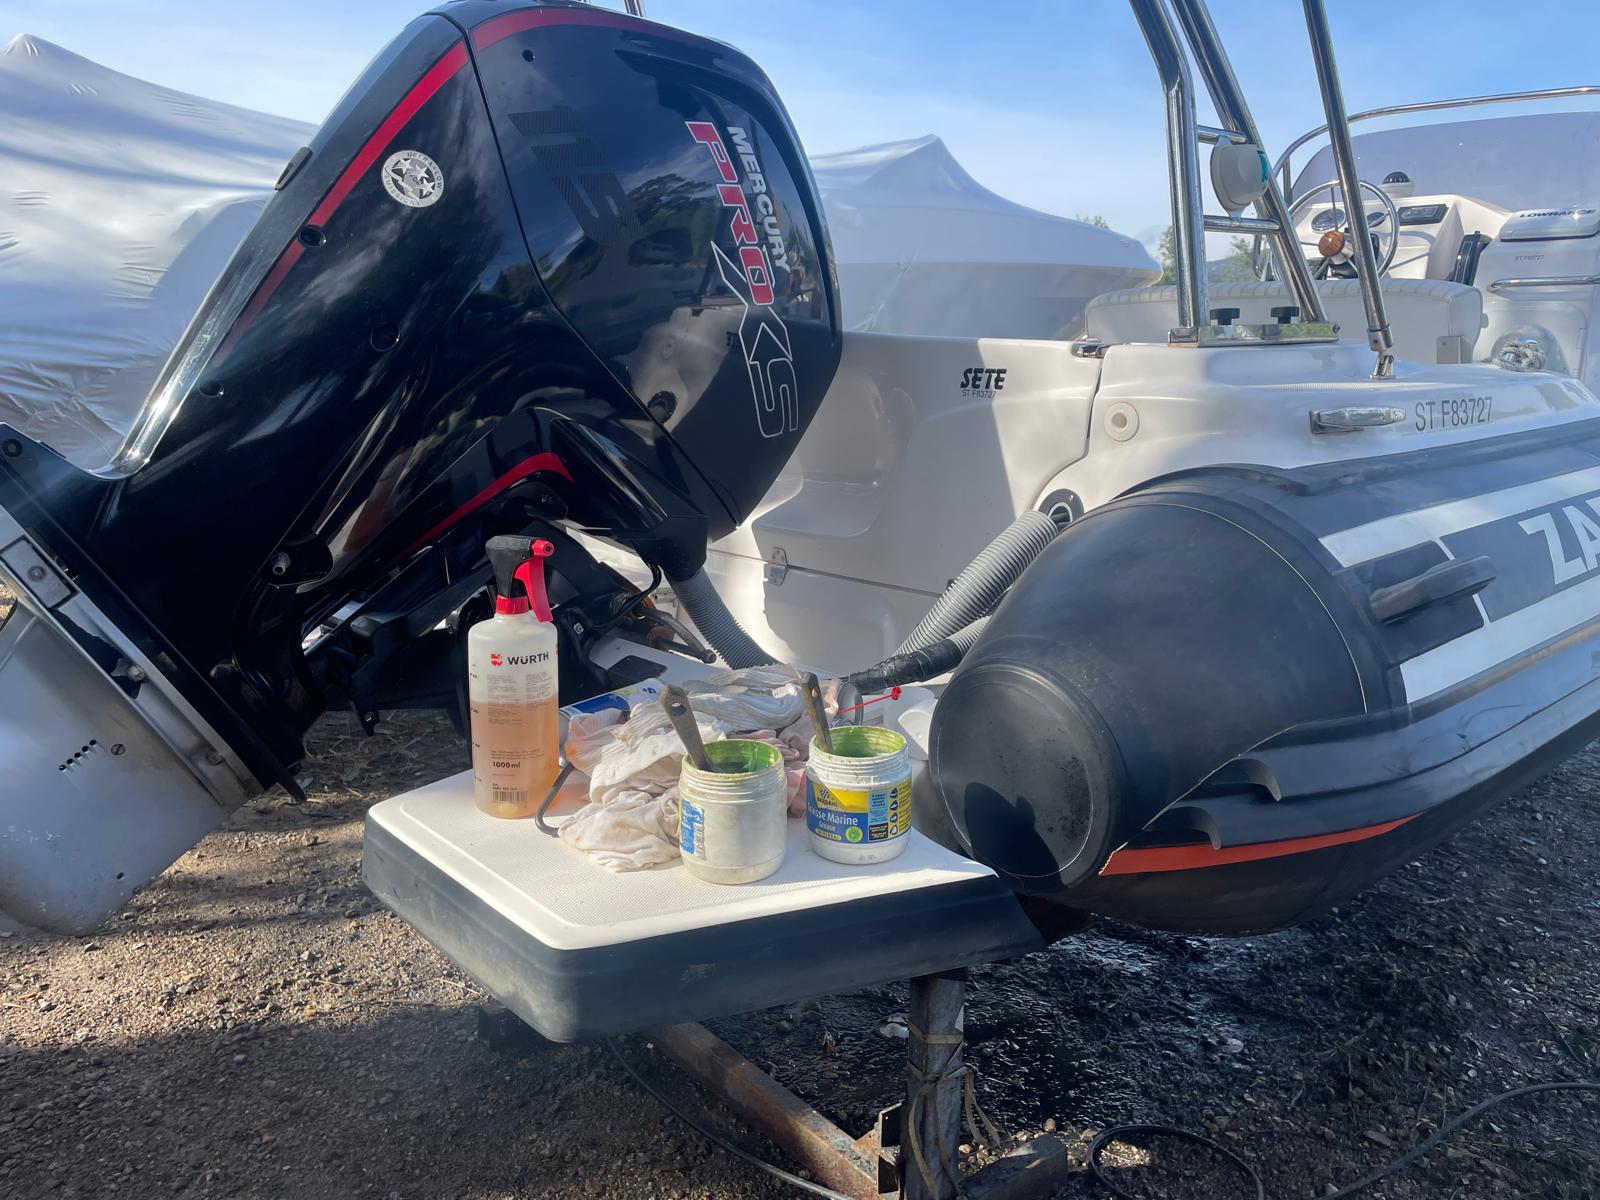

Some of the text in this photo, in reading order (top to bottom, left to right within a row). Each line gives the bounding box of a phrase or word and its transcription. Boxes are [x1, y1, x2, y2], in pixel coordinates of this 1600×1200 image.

[685, 121, 775, 305] PRO
[727, 126, 791, 273] MERCURY
[960, 368, 1007, 390] SETE
[971, 390, 996, 398] F83727
[1415, 396, 1493, 431] ST F83727
[1518, 496, 1600, 585] ZA
[507, 651, 549, 666] WÜRTH
[827, 812, 858, 826] Marine
